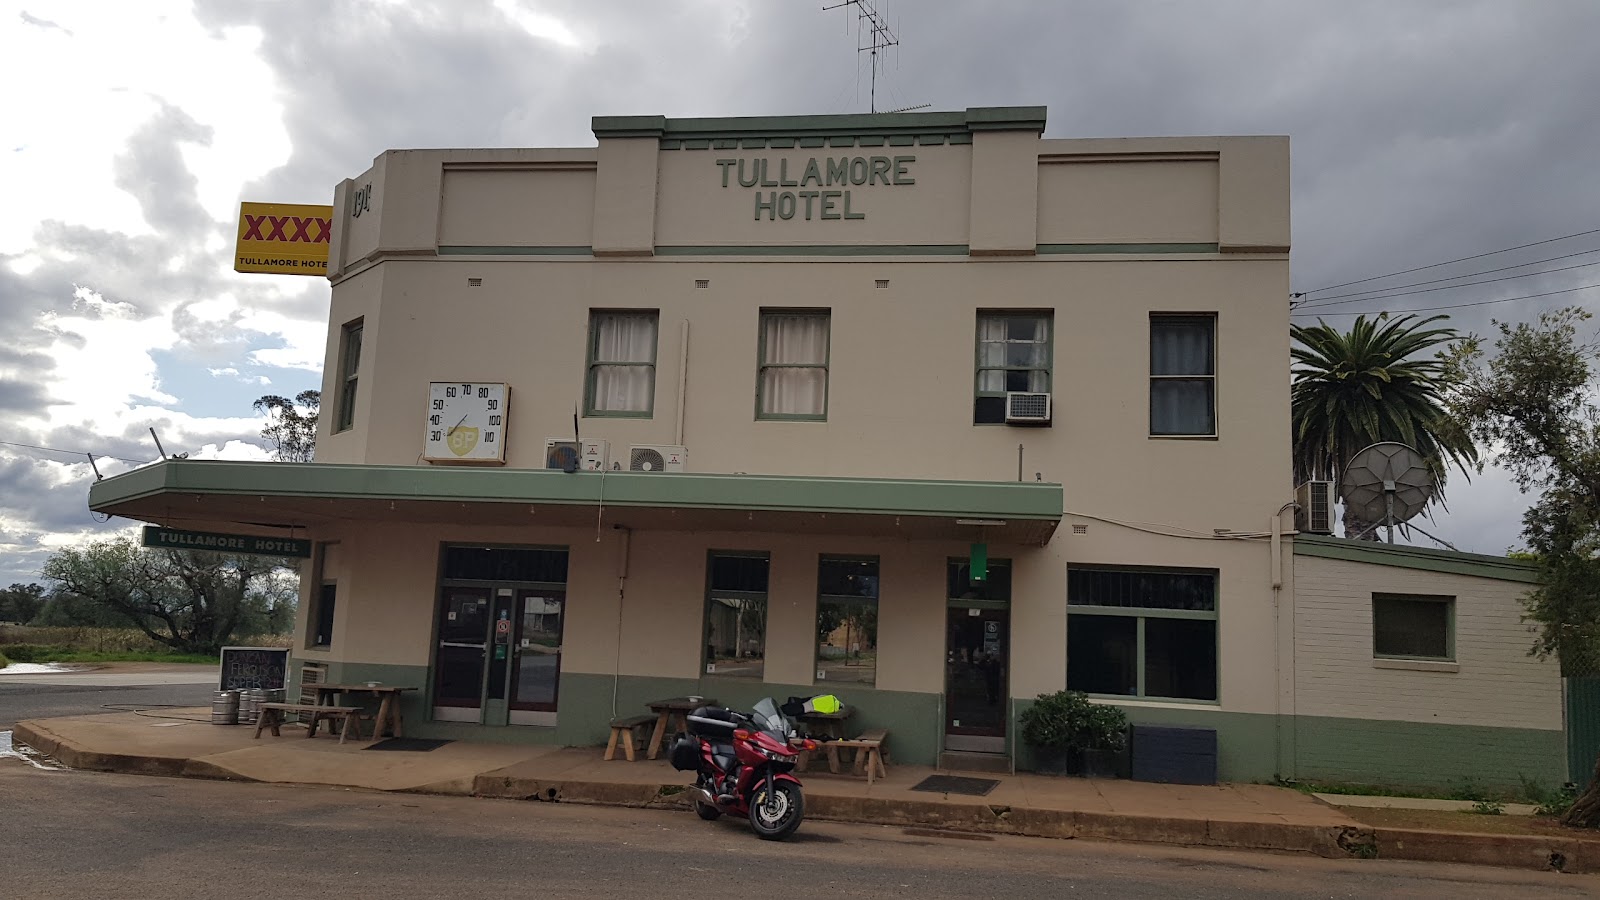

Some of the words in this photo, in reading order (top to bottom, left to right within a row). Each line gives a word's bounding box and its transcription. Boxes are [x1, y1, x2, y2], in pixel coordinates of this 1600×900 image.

[716, 156, 915, 187] TULLAMORE
[755, 191, 865, 220] HOTEL
[242, 214, 332, 243] XXXX
[239, 257, 298, 267] TULLAMORE
[301, 260, 328, 268] HOTE
[446, 386, 456, 398] 60
[462, 384, 472, 396] 70
[478, 388, 488, 398] 80
[434, 400, 444, 410] 50
[488, 400, 498, 410] 90
[430, 414, 440, 426] 40
[488, 416, 500, 426] 100
[430, 430, 440, 442] 30
[484, 432, 494, 442] 110
[159, 532, 245, 549] TULLAMORE
[255, 539, 299, 552] HOTEL
